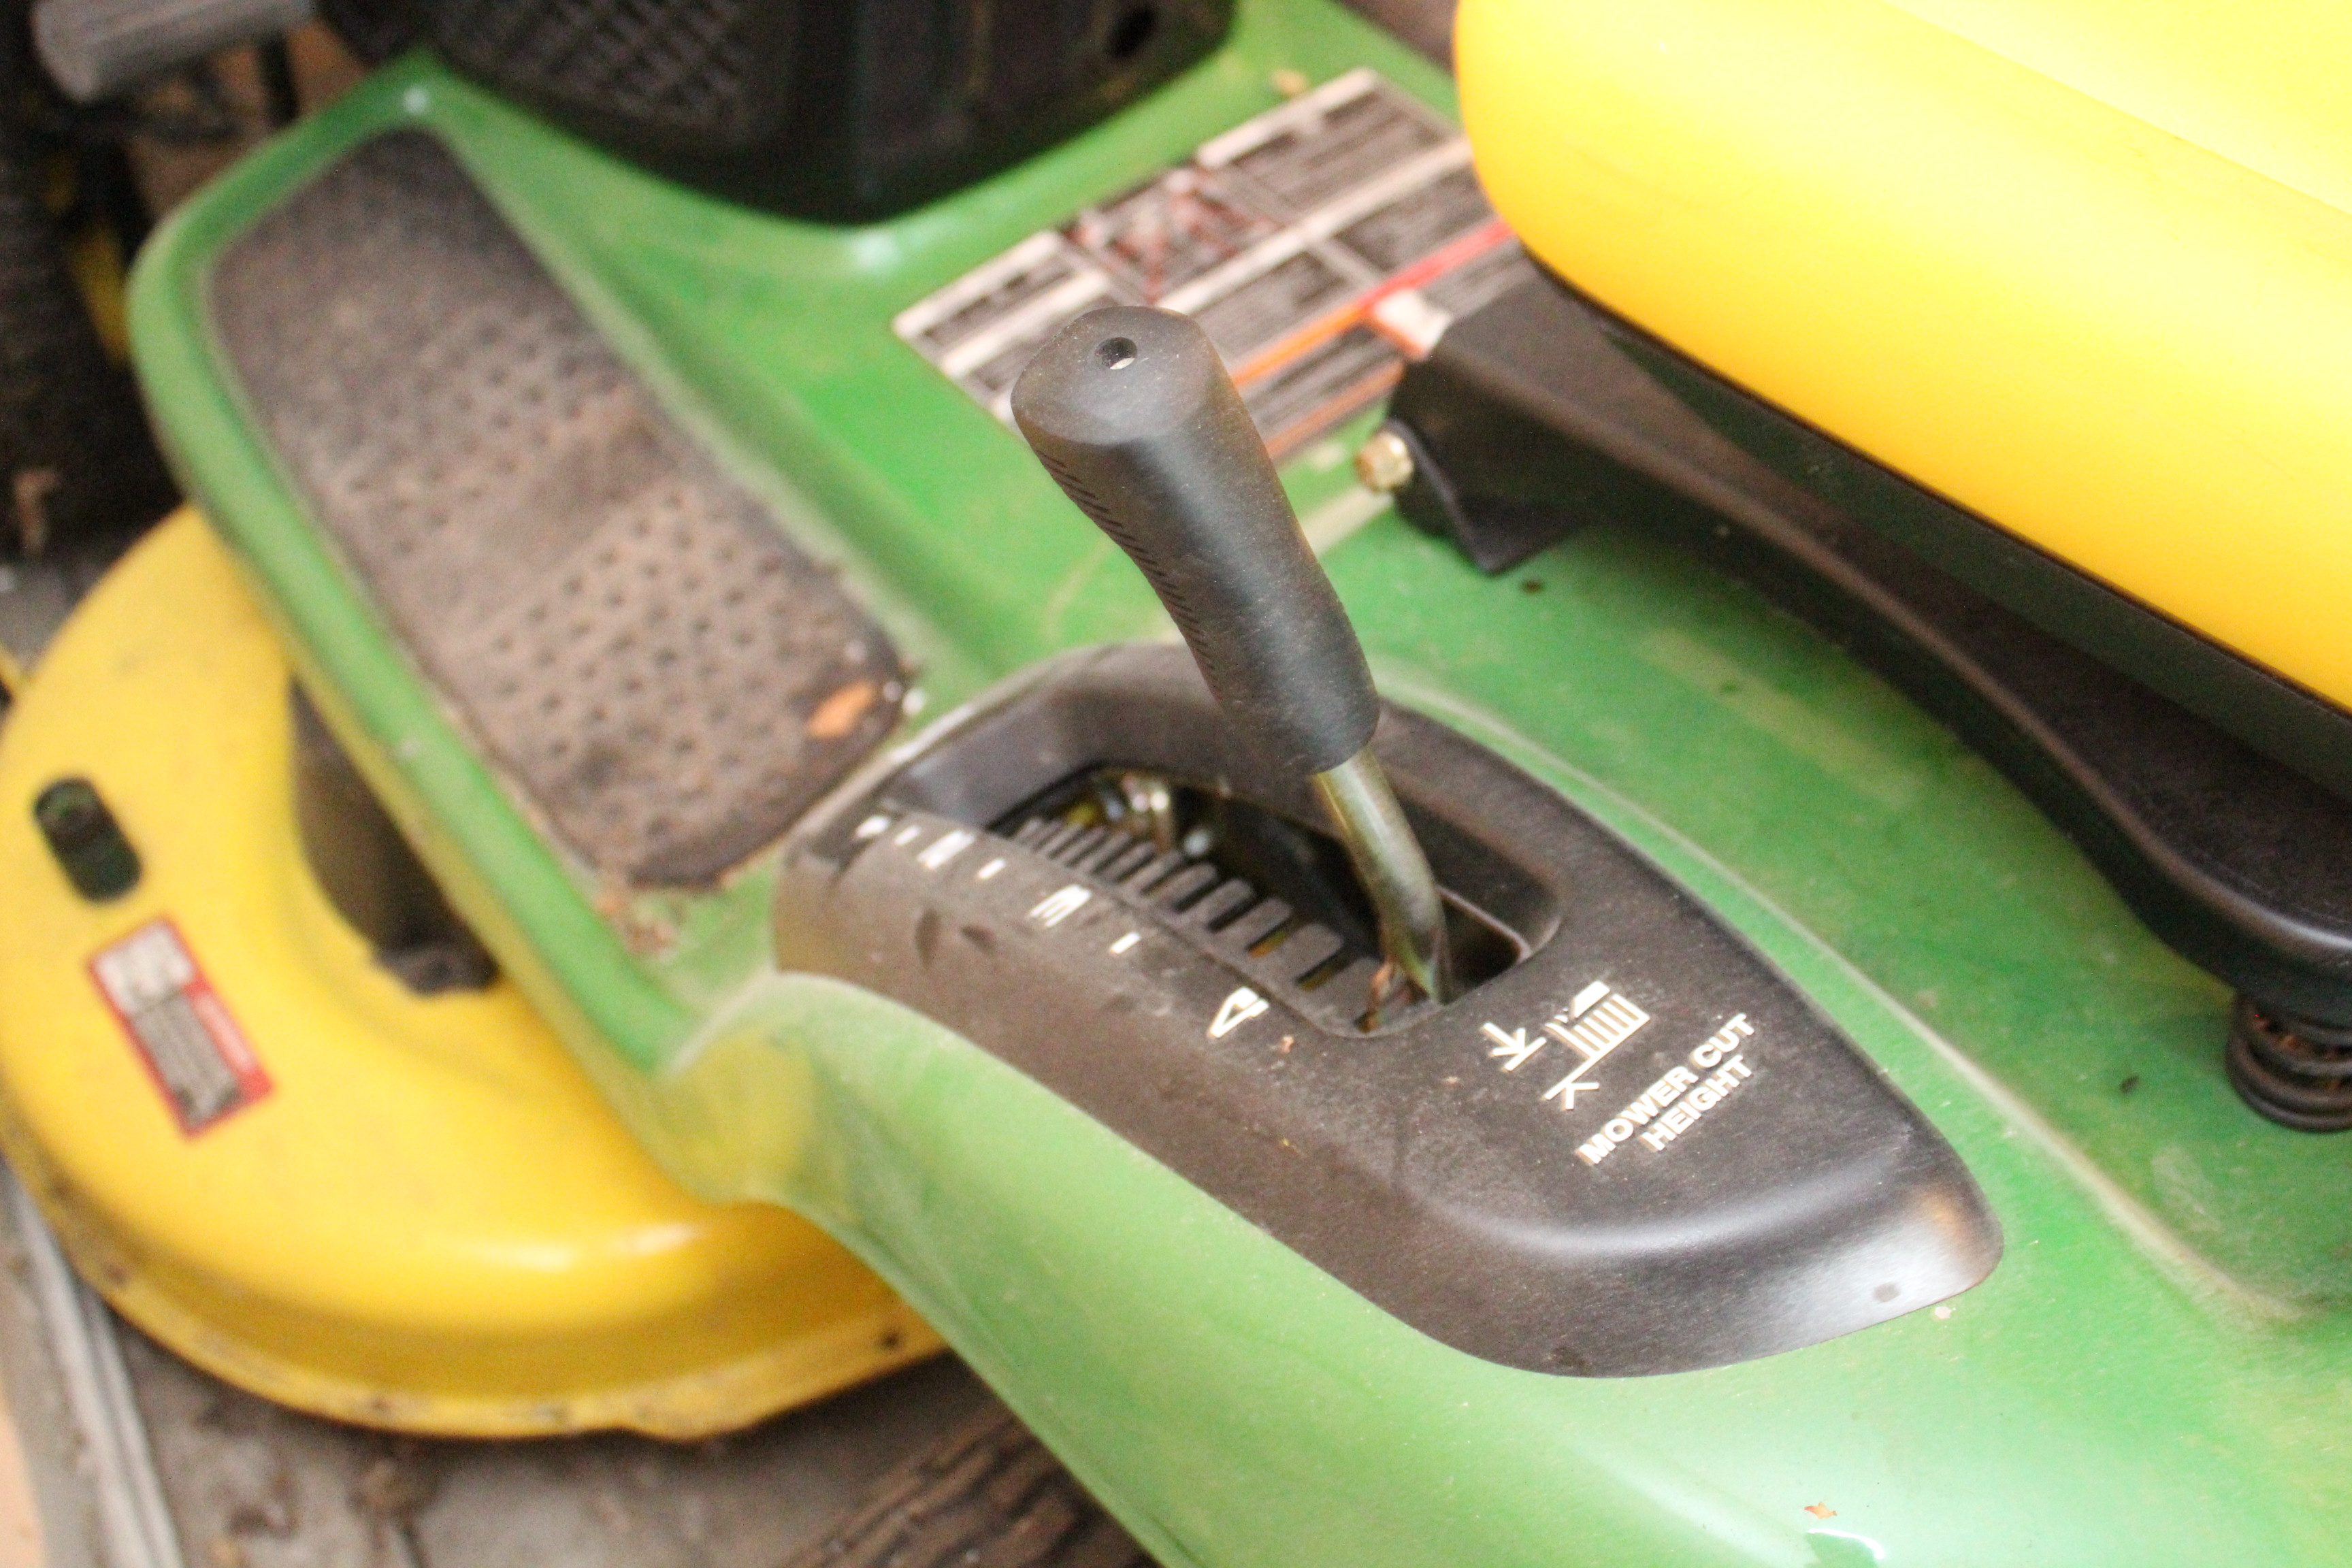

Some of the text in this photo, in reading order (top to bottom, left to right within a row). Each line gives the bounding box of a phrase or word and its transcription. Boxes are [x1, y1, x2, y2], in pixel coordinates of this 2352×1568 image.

[1576, 1013, 1755, 1165] MOWER CUT
[1639, 1054, 1752, 1152] HEIGHT
